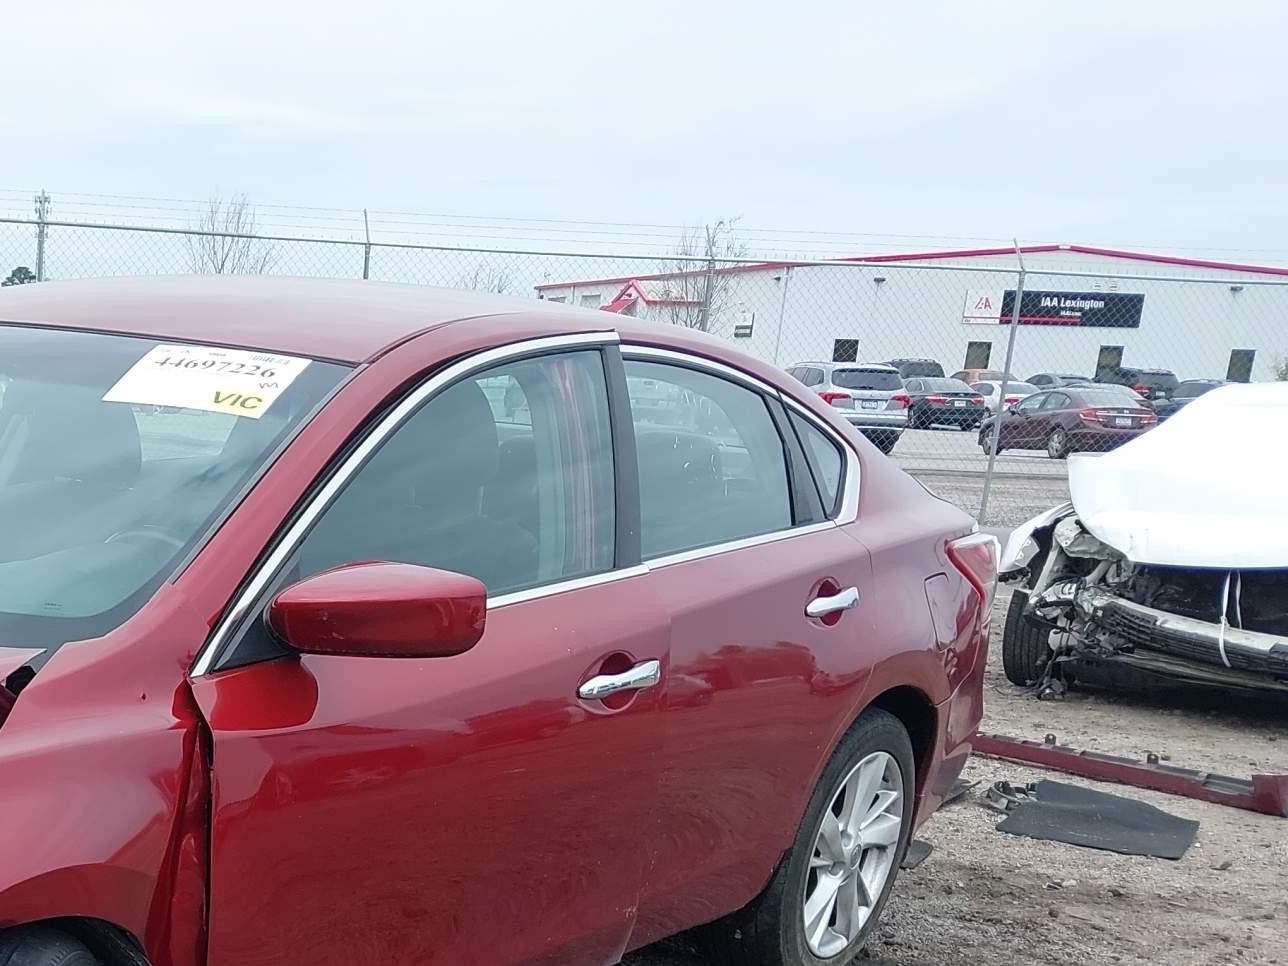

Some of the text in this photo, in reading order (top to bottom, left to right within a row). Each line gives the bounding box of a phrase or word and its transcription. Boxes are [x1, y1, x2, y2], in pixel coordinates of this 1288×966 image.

[1041, 296, 1105, 310] IAA Lexington
[154, 356, 276, 378] 44697226
[213, 390, 263, 410] VIC
